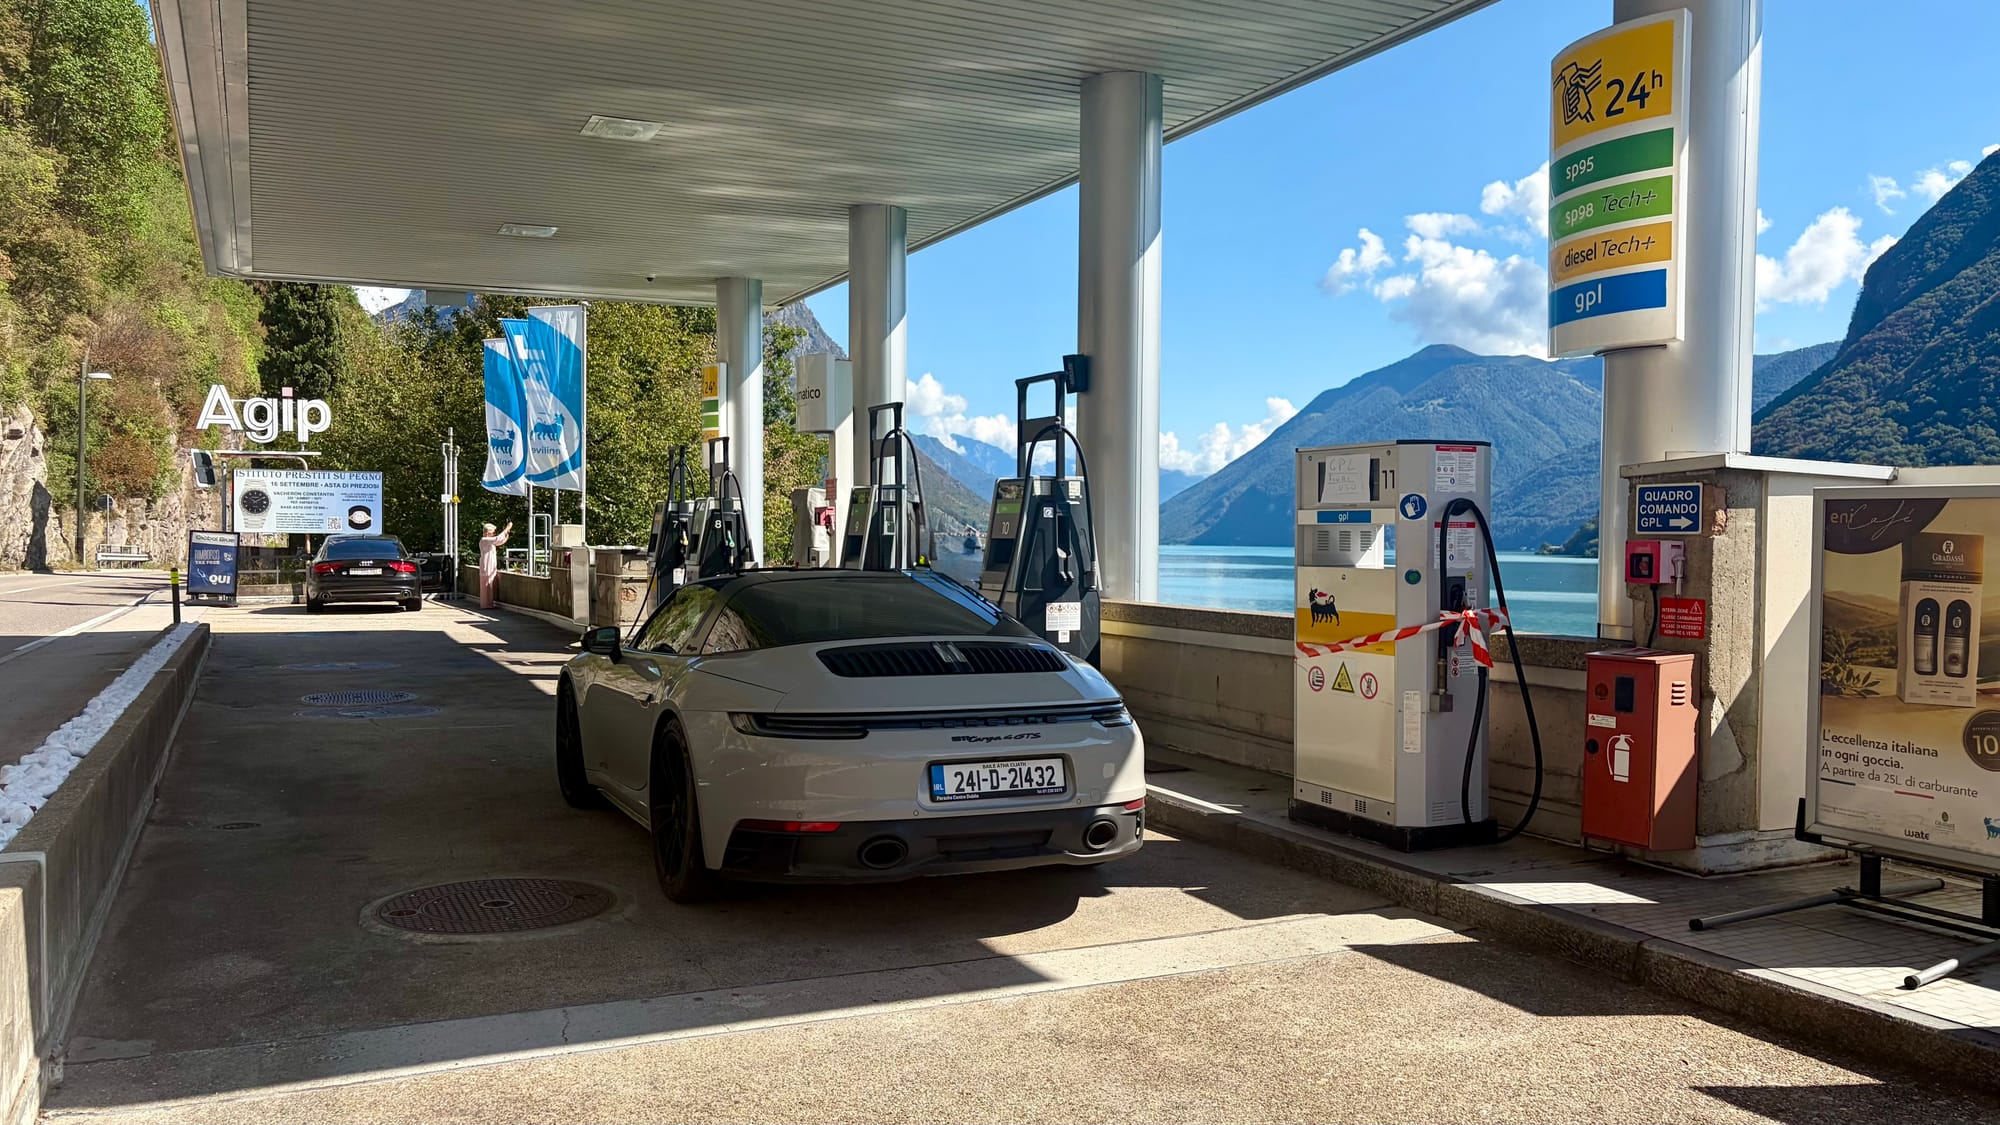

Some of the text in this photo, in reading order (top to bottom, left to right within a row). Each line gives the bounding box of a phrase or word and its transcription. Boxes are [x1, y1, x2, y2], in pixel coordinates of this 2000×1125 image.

[1605, 69, 1663, 118] 24h
[1566, 156, 1594, 182] sp95
[1565, 190, 1657, 227] sp98 Tech+
[1564, 235, 1656, 268] diesel Tech+
[1574, 283, 1602, 313] gpl
[196, 384, 332, 444] Agip
[235, 470, 381, 481] ISTITUTO PRESTITI SU PEGNO
[1382, 470, 1395, 489] 11
[1644, 490, 1693, 502] QUADRO
[1338, 511, 1349, 523] gpl
[1640, 503, 1698, 515] COMANDO
[673, 520, 679, 529] 7
[714, 519, 722, 529] 8
[1641, 517, 1663, 528] GPL
[208, 574, 231, 585] QUI
[1822, 729, 1939, 758] L'eccellenza italiana
[1821, 746, 1904, 769] in ogni goccia.
[954, 765, 1057, 793] 241-D-21432
[1821, 761, 1979, 798] A partire da 25L di carburante
